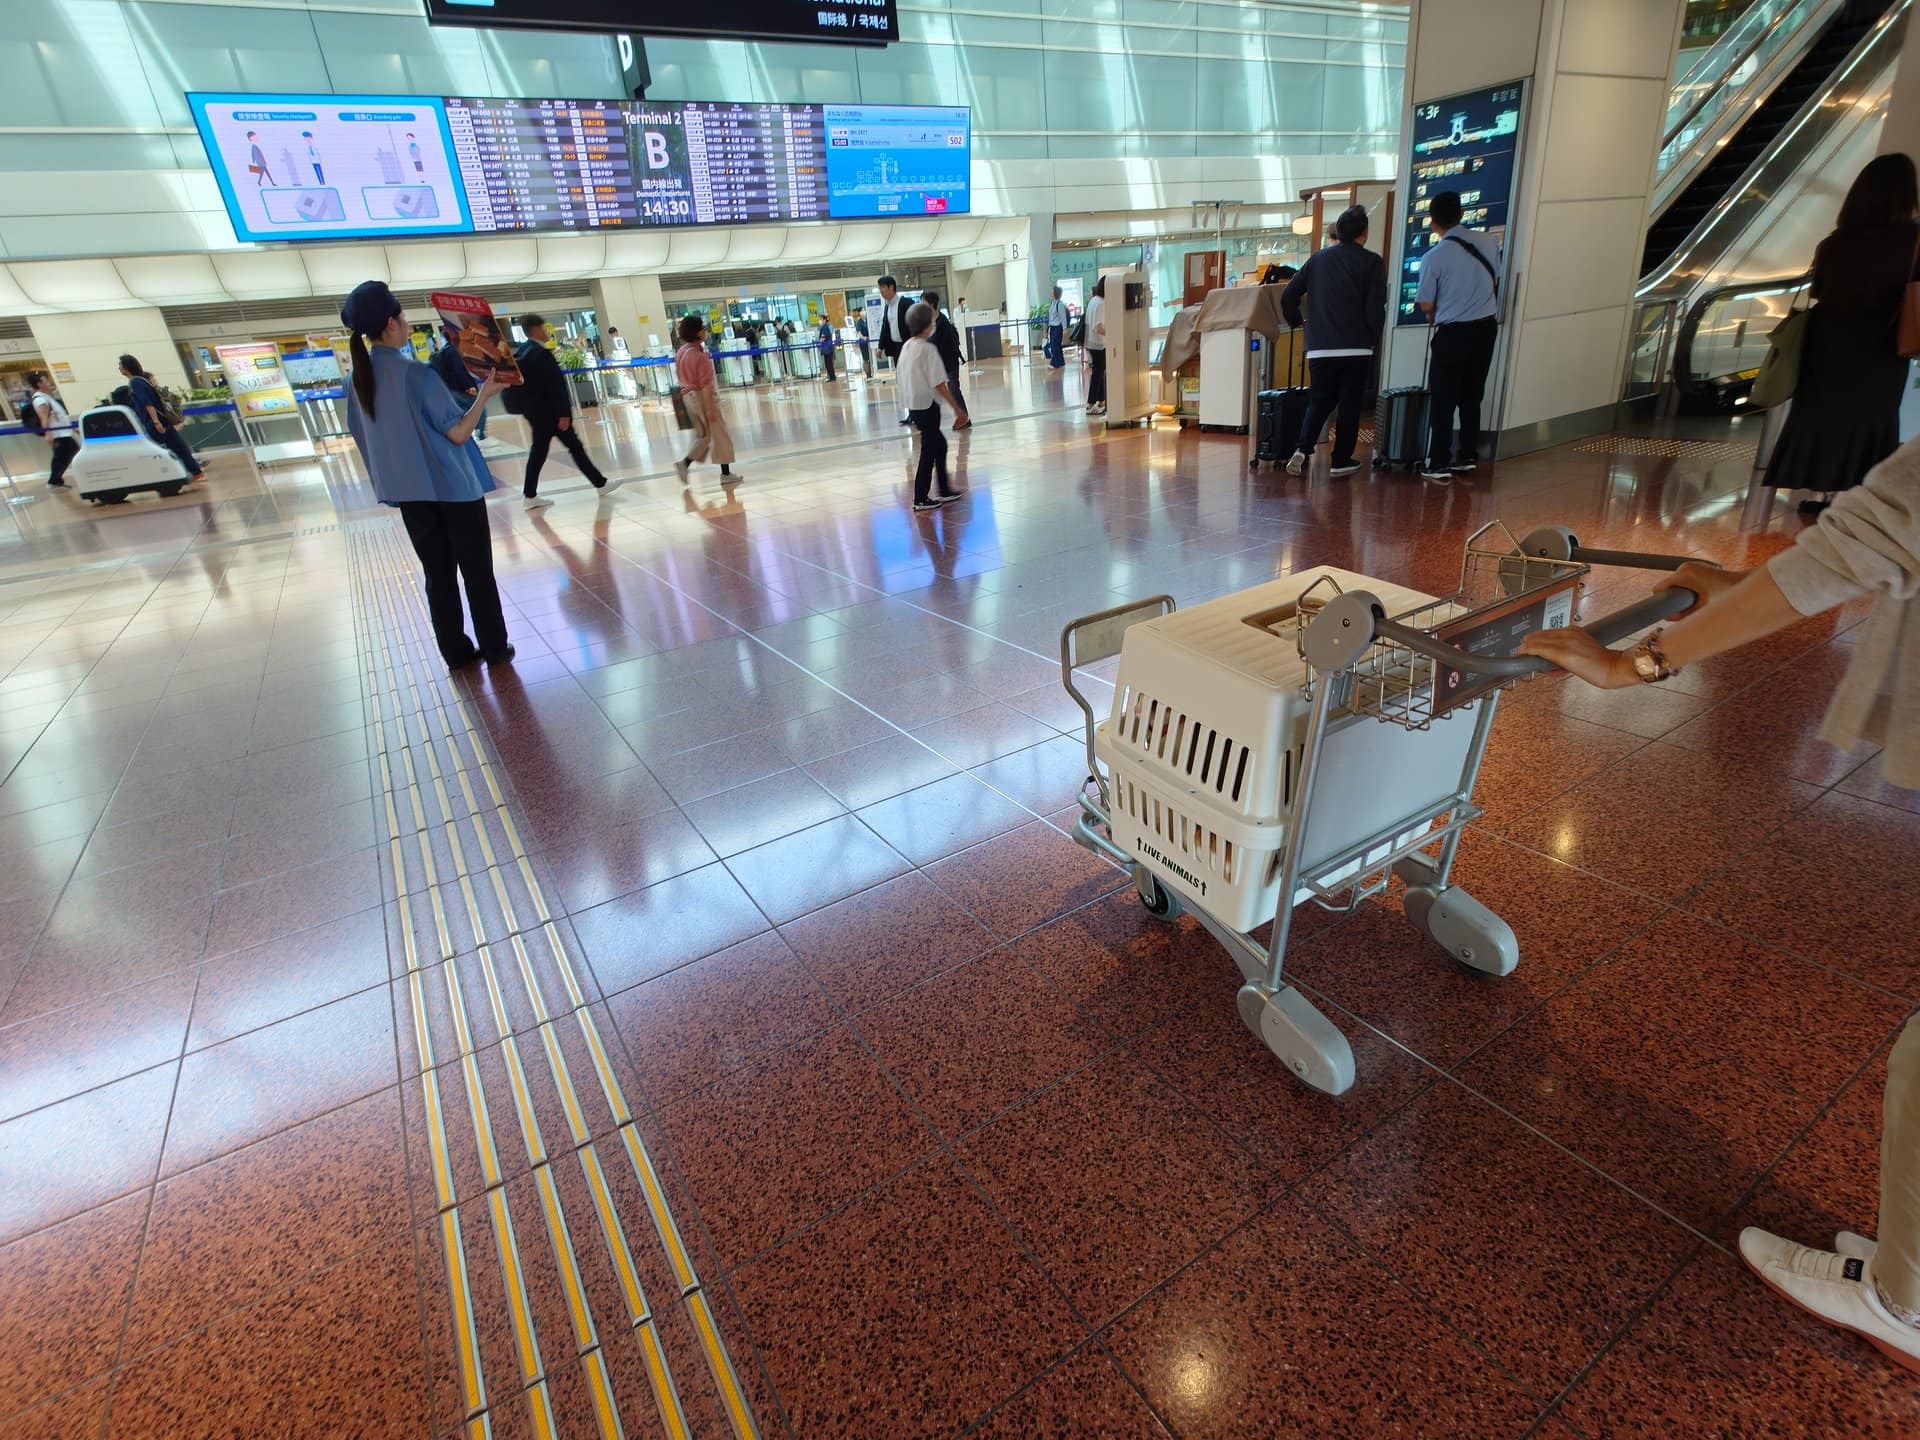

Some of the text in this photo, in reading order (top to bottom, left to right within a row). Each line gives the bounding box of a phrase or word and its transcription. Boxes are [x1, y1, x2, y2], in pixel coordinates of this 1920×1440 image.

[817, 11, 849, 27] 国际线
[858, 14, 889, 30] 국제선
[617, 34, 633, 72] D
[622, 111, 672, 125] Terminal
[674, 112, 682, 125] 2
[1425, 105, 1440, 120] 3F
[949, 137, 962, 145] 502
[644, 132, 670, 169] B
[641, 178, 682, 190] 国内線出発
[636, 190, 661, 198] Domestic
[642, 200, 689, 217] 14:30
[1012, 243, 1019, 259] B
[1143, 842, 1200, 888] LIVE ANIMALS
